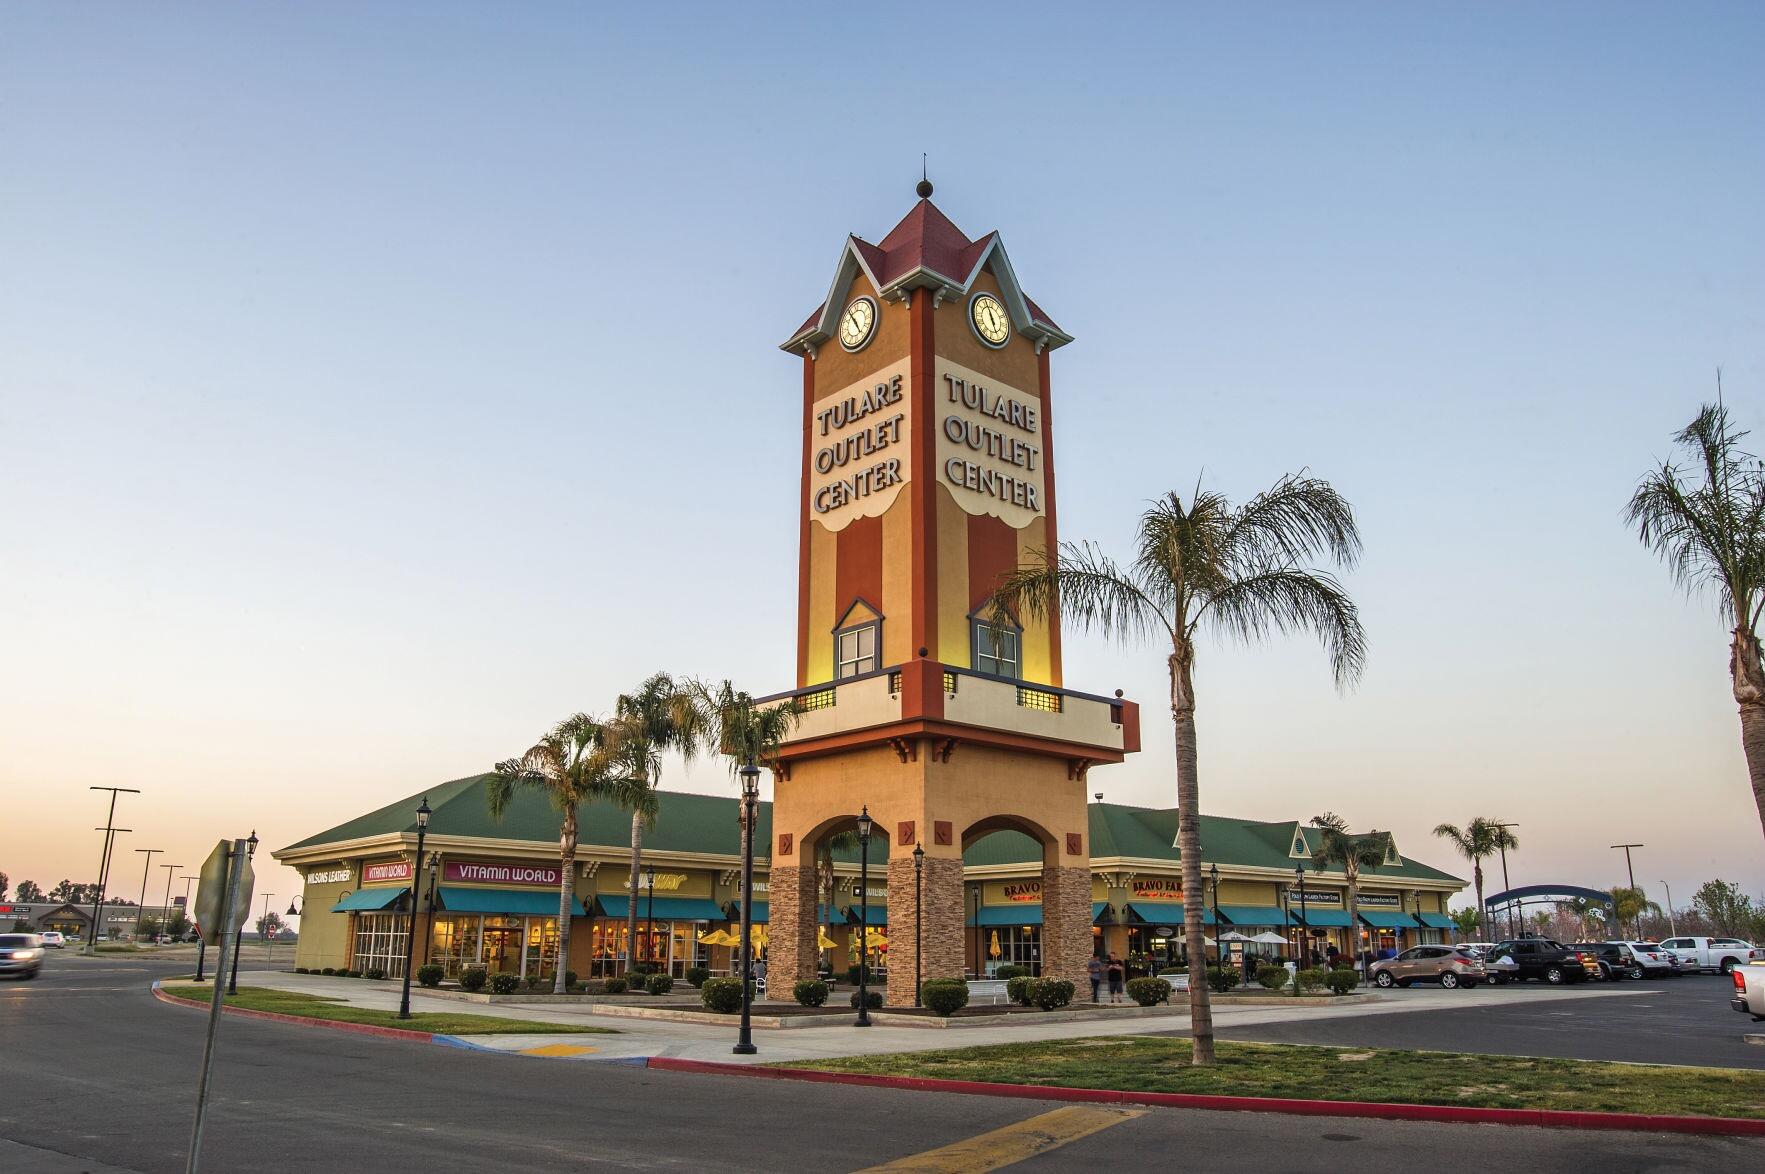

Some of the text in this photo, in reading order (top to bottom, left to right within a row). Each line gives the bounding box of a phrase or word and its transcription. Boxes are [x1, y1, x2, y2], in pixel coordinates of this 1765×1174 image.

[817, 374, 903, 436] TULARE
[944, 372, 1036, 433] TULARE
[814, 413, 903, 474] OUTLET
[944, 415, 1039, 471] OUTLET
[813, 457, 903, 513] CENTER
[945, 457, 1040, 511] CENTER
[307, 870, 350, 884] WILSONS LEATHER
[388, 864, 407, 878] WORLD
[460, 865, 556, 882] VITAMIN WORLD
[1004, 882, 1040, 896] BRAVO
[1133, 880, 1163, 891] BRAVO
